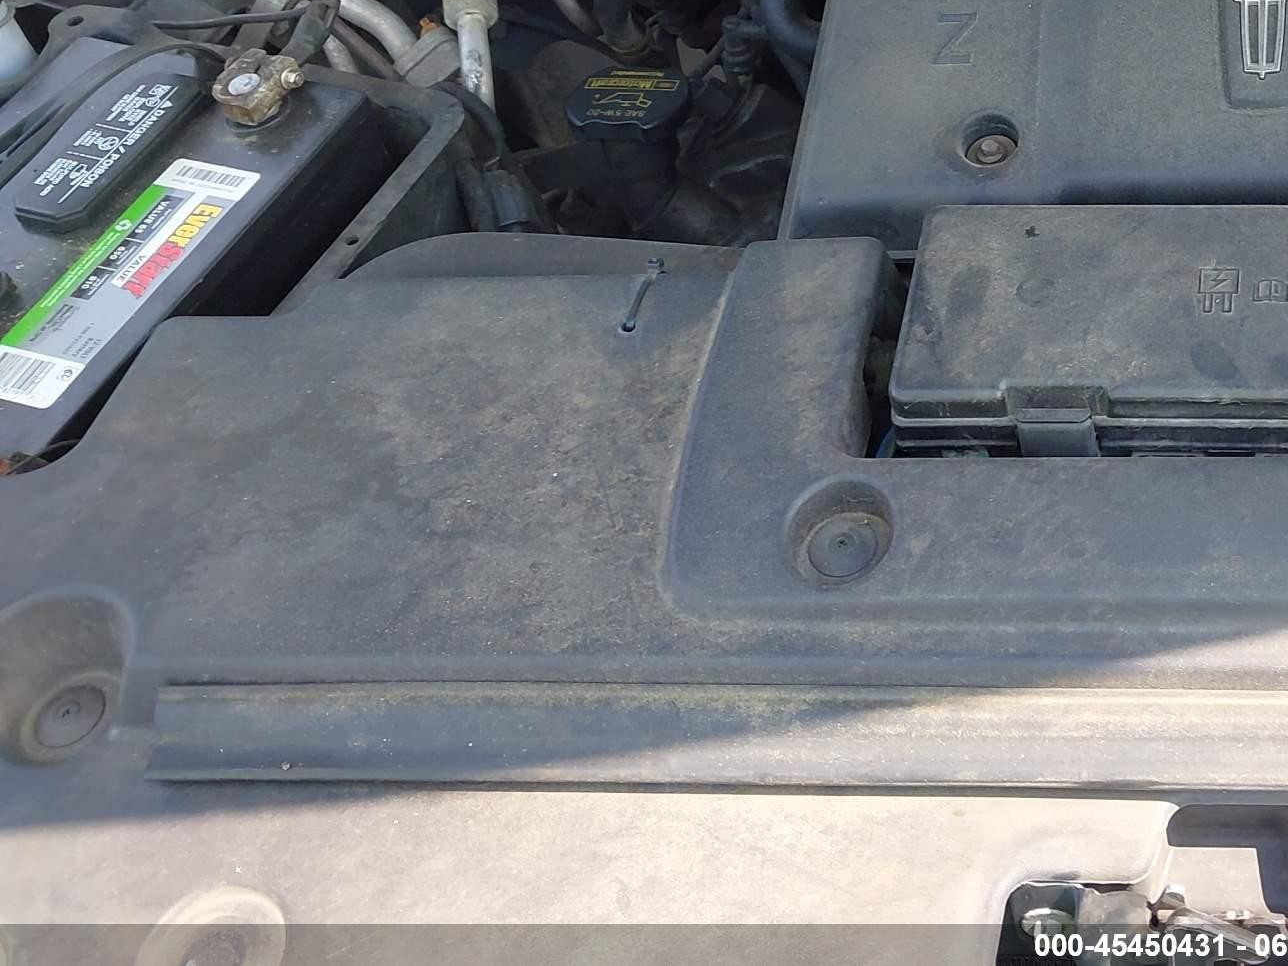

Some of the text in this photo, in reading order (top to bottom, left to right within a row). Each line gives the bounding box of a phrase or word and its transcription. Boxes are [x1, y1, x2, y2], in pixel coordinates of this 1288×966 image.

[124, 109, 165, 146] DANGER
[81, 153, 121, 188] POISON
[143, 200, 170, 227] VALUE
[118, 255, 147, 282] VALUE
[122, 203, 224, 299] EverStart
